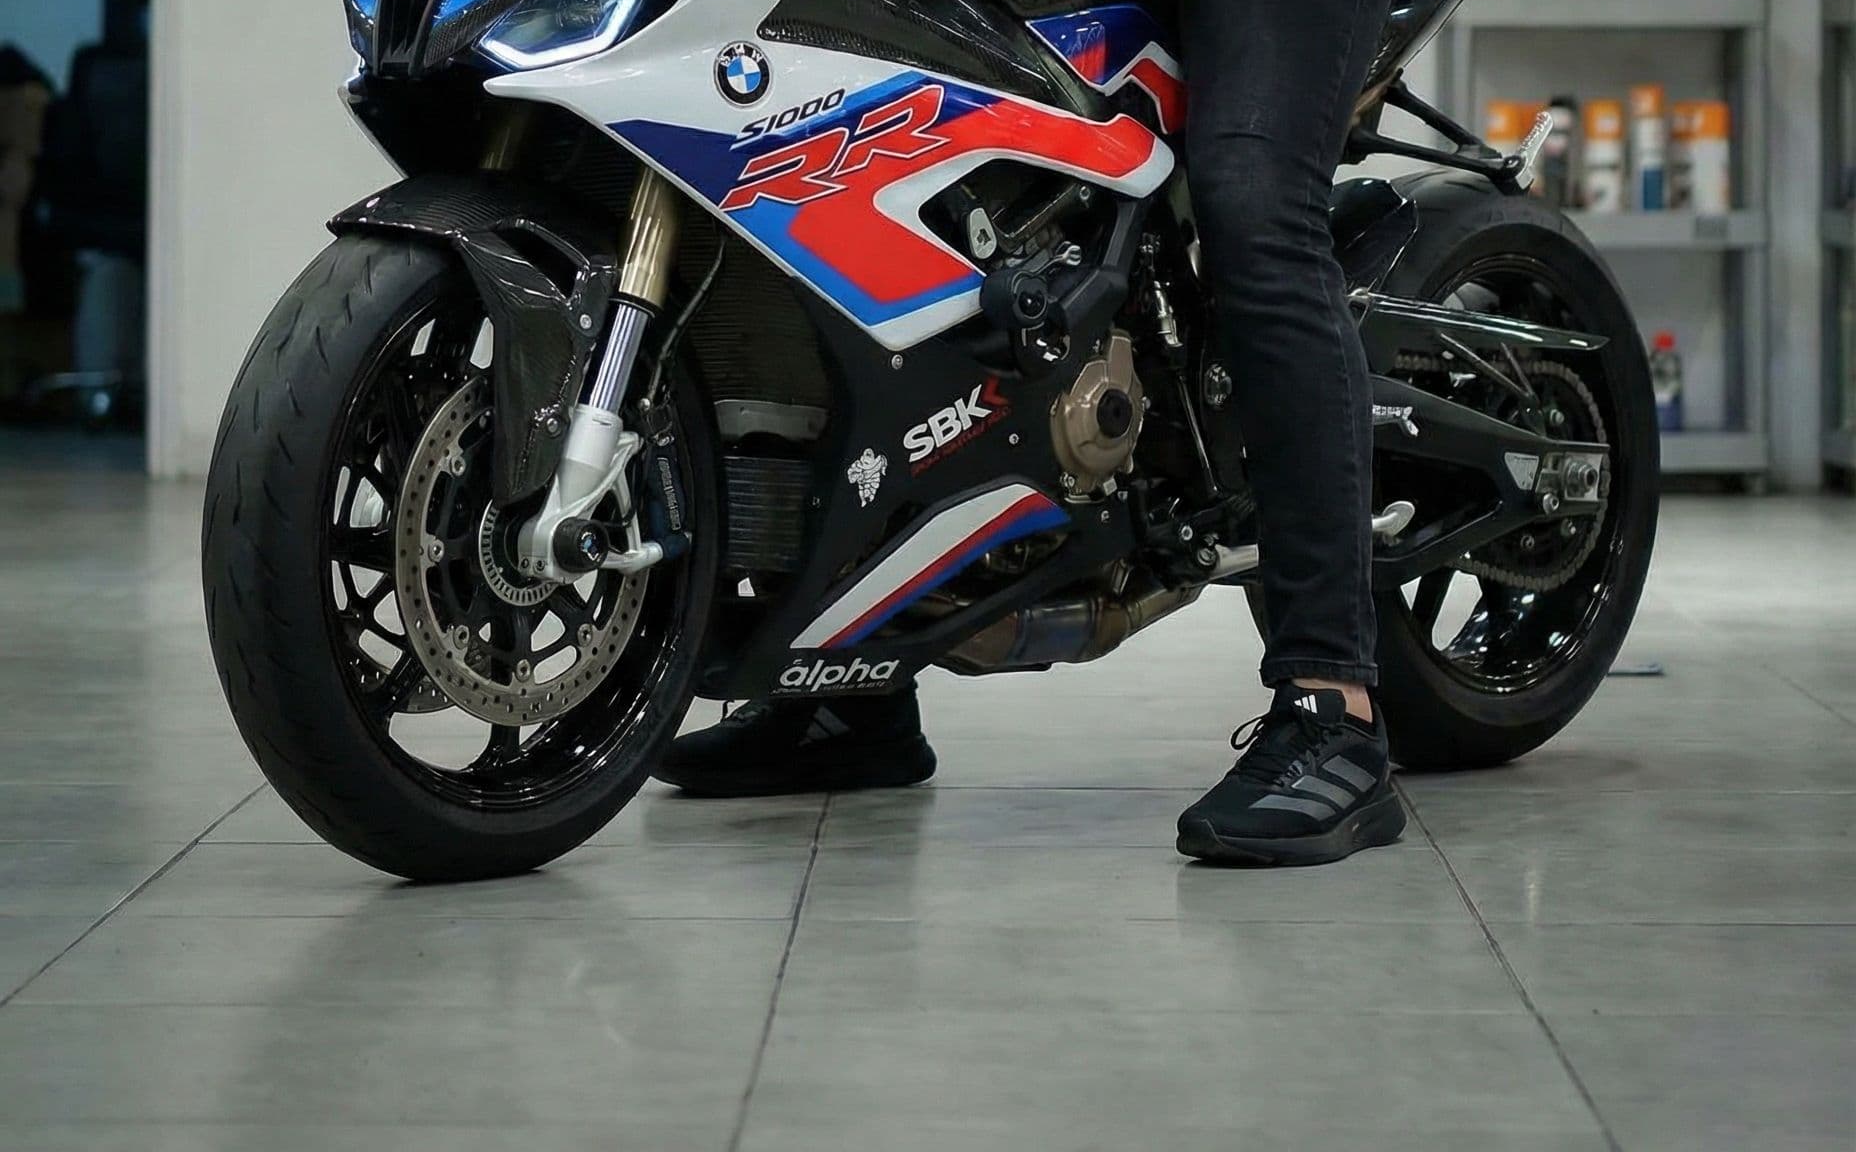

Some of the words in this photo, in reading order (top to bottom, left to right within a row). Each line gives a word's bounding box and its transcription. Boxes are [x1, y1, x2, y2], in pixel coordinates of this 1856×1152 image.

[740, 88, 846, 139] S1000
[718, 84, 951, 212] RR
[903, 383, 993, 462] SBK
[780, 657, 900, 692] alpha
